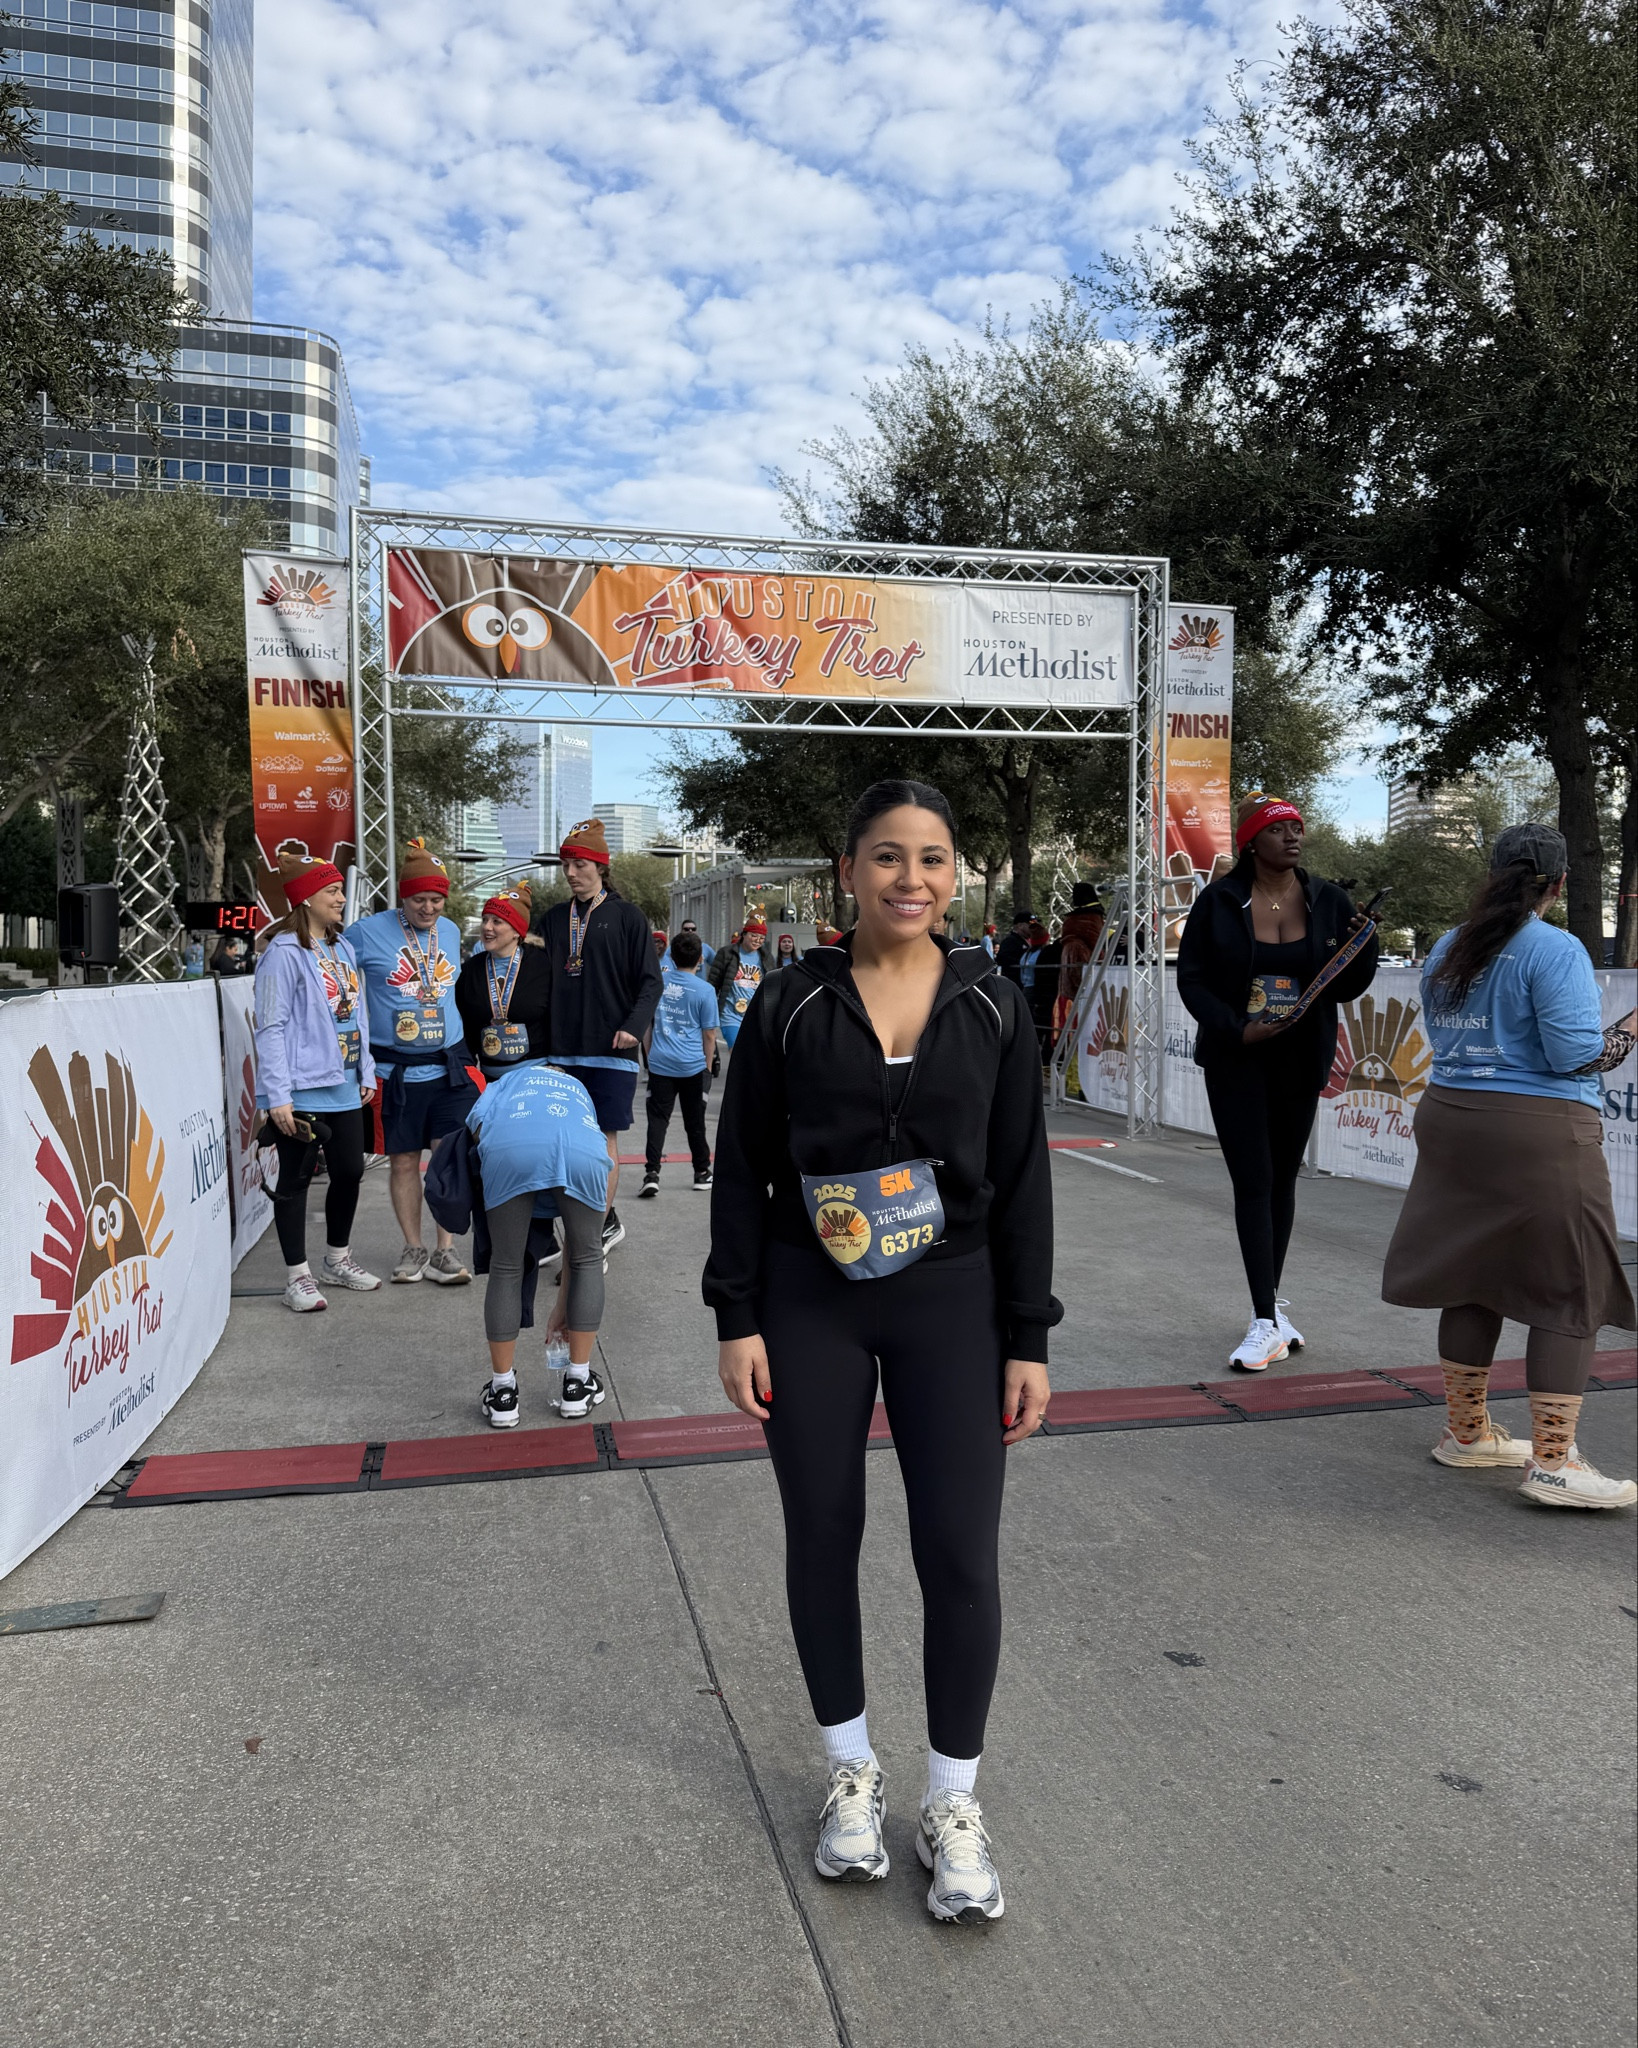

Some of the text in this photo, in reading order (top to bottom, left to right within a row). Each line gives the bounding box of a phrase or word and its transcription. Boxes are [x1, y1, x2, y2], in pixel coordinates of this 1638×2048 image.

[272, 606, 325, 621] Turkey Trot
[666, 578, 875, 631] HOUSTON
[992, 611, 1093, 627] PRESENTED BY
[279, 626, 307, 634] PRESENTED
[255, 641, 340, 661] Methodist
[612, 607, 924, 689] Turkey Trot
[963, 638, 1026, 649] HOUSTON
[963, 647, 1119, 681] Methodist
[1178, 650, 1203, 662] Turkey
[254, 677, 346, 709] FINISH
[274, 731, 316, 741] Walmart
[1170, 759, 1202, 768] Walmart
[1342, 943, 1359, 961] 2025
[1275, 978, 1292, 990] 5K
[505, 1025, 519, 1035] 5K
[1431, 1012, 1490, 1030] Methodst
[422, 1029, 443, 1040] 1914
[504, 1045, 525, 1055] 1913
[526, 1078, 590, 1104] Methodist
[1346, 1091, 1403, 1113] HOUSTON
[179, 1108, 209, 1140] HOUSTON
[1334, 1103, 1381, 1139] Turkey
[1362, 1149, 1405, 1168] Methodist
[813, 1168, 916, 1204] 2025 5K
[871, 1205, 900, 1216] HOUSTON
[873, 1200, 938, 1227] Methodist
[827, 1239, 847, 1250] Turkey
[880, 1223, 935, 1257] 6373
[76, 1260, 148, 1341] HOUSTON
[64, 1282, 164, 1409] Turkey Trot
[107, 1371, 155, 1436] Methodist
[108, 1384, 131, 1410] HOUSTON
[72, 1415, 107, 1447] PRESENTED BY
[1529, 1470, 1568, 1489] HOKA
